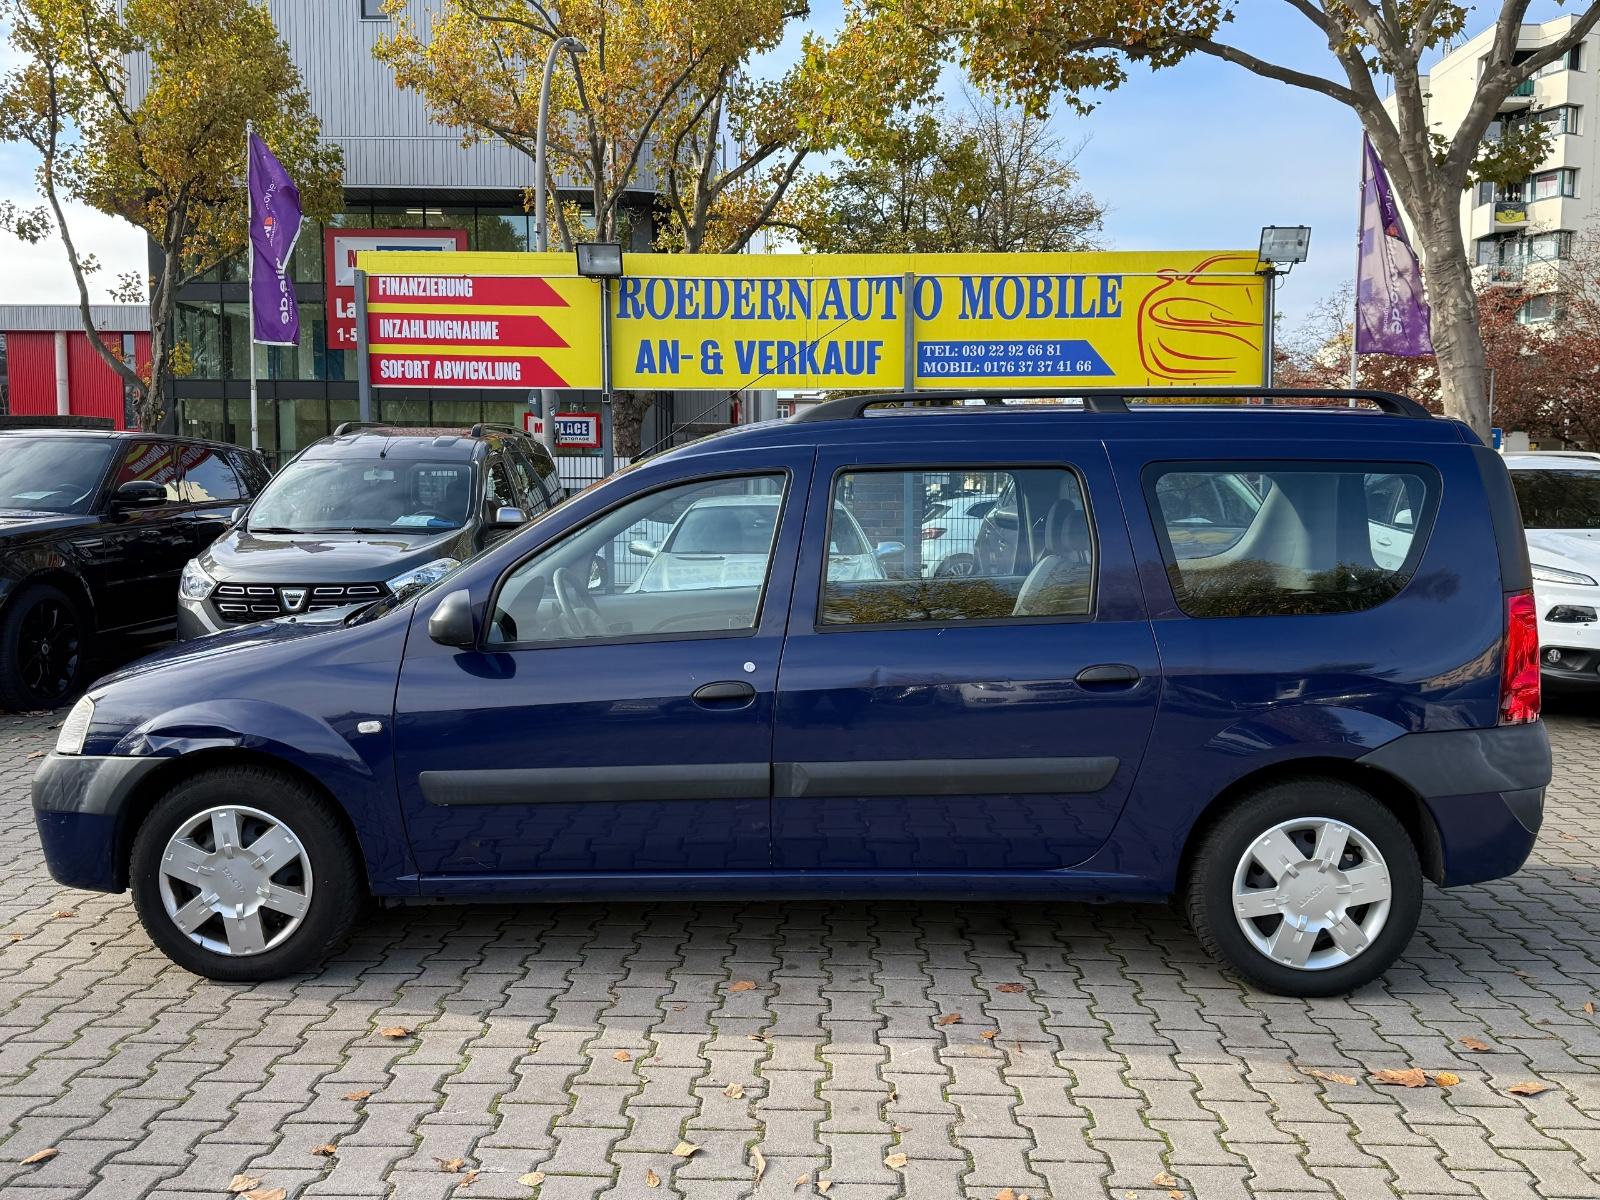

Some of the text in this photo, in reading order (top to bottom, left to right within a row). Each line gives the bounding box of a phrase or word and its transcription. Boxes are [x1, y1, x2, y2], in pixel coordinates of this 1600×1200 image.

[378, 277, 473, 297] FINANZIERUNG
[958, 275, 1123, 320] MOBILE
[336, 298, 356, 318] La
[379, 319, 499, 340] INZAHLUNGNAHME
[635, 339, 884, 375] AN- & VERKAUF
[923, 344, 1062, 357] TEL: 030 22 92 66 81
[380, 360, 521, 381] SOFORT ABWICKLUNG
[923, 360, 1092, 373] MOBIL: 0176 37 37 41 66
